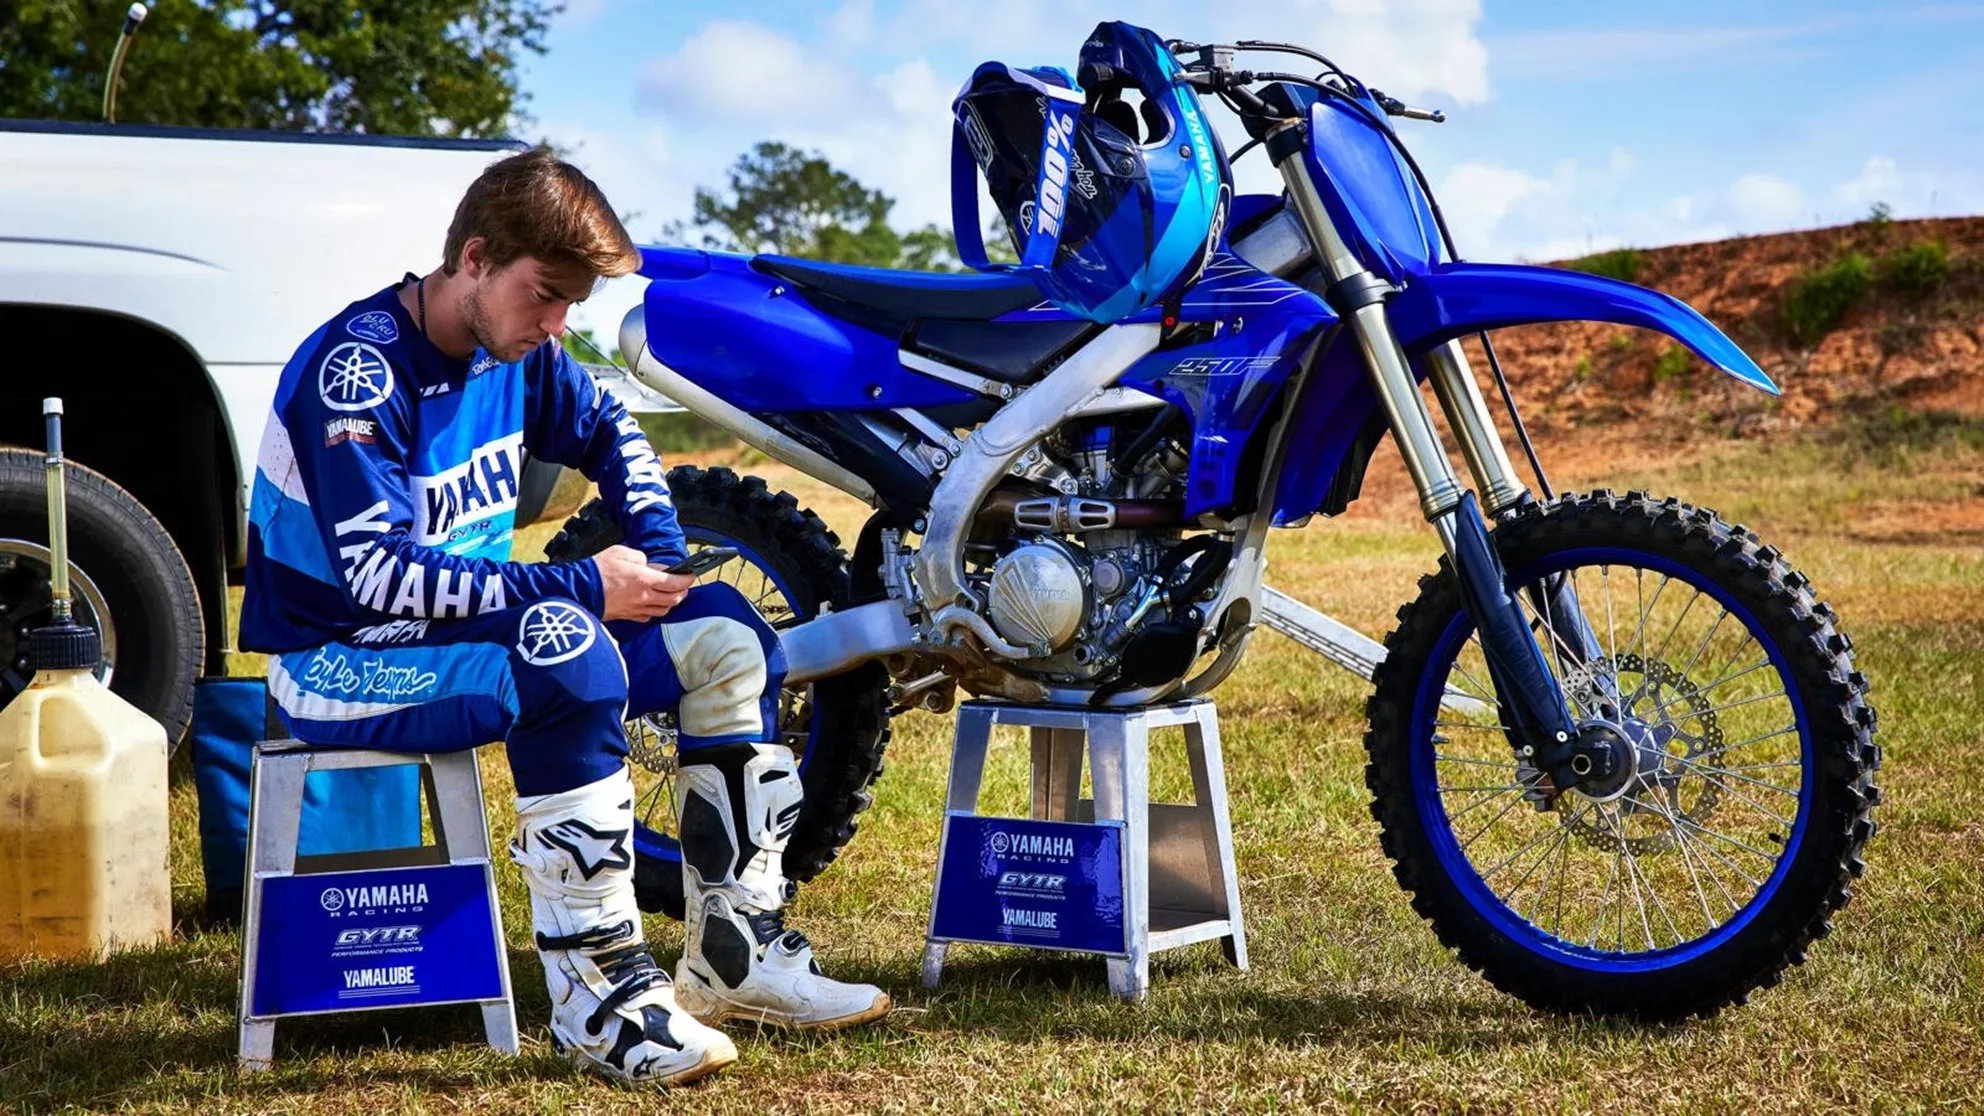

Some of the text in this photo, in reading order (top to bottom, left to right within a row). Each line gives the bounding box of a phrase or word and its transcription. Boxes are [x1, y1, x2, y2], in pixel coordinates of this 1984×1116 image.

[1187, 110, 1214, 184] YAMAHA
[1038, 110, 1074, 238] 100%
[1168, 356, 1282, 376] 250F
[326, 418, 375, 438] YAMALUBE
[427, 445, 522, 535] YAAH
[334, 500, 507, 618] YAMAHA
[1010, 834, 1074, 857] YAMAHA
[997, 854, 1069, 864] RACING
[1000, 873, 1065, 888] GYTR
[345, 883, 429, 908] YAMAHA
[330, 907, 424, 917] RACING
[1002, 908, 1057, 928] YAMALUBE
[336, 925, 421, 944] GYTR
[331, 946, 423, 957] PERFORMANCE PRODUCTS
[343, 965, 415, 988] YAMALUBE
